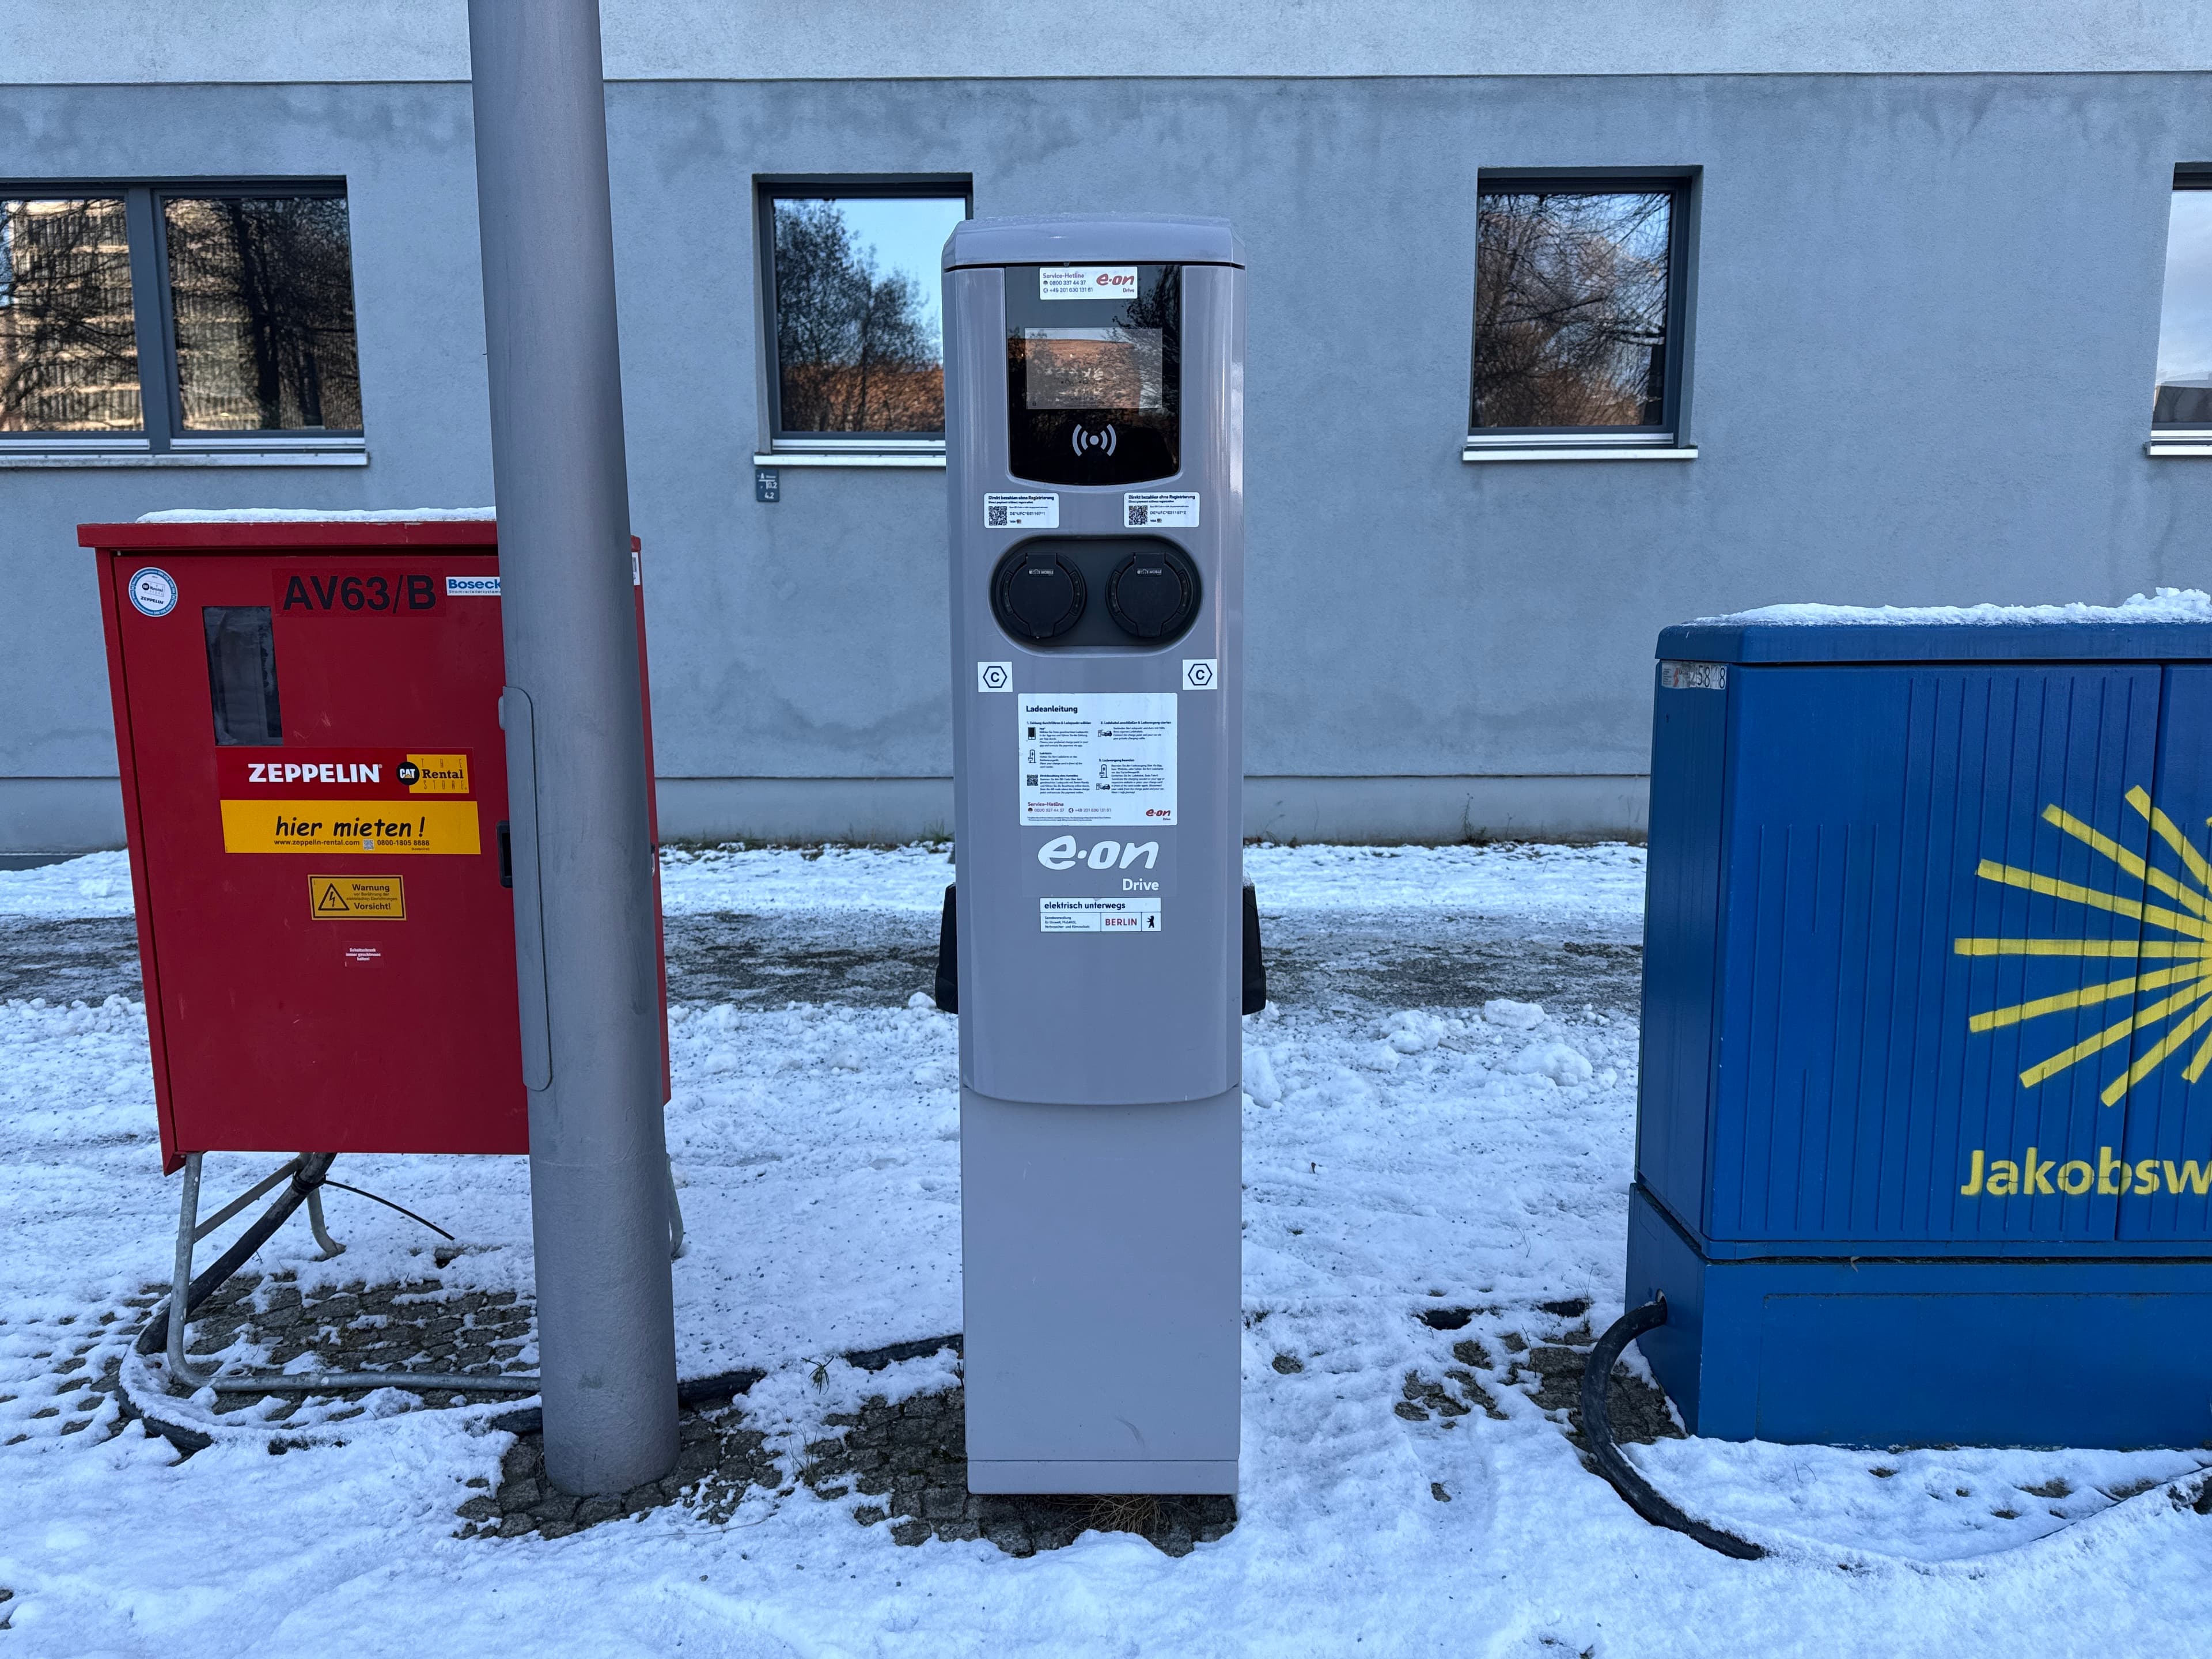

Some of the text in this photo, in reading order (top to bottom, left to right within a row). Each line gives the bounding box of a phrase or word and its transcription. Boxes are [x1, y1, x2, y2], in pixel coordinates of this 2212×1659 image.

[141, 596, 164, 604] ZEPPELIN
[283, 575, 436, 614] AV63/B
[990, 672, 1000, 683] C
[1195, 669, 1205, 680] C
[1026, 705, 1078, 714] Ladeanleitung
[248, 764, 380, 782] ZEPPELIN
[399, 768, 415, 779] CAT
[422, 769, 464, 779] Rental
[275, 816, 323, 836] hier
[333, 817, 411, 837] mieten
[352, 884, 390, 893] Warnung
[1123, 878, 1159, 891] Drive
[1044, 901, 1126, 910] elektrisch unterwegs
[1105, 918, 1137, 926] BERLIN
[1961, 1146, 2212, 1196] Jakobsw
